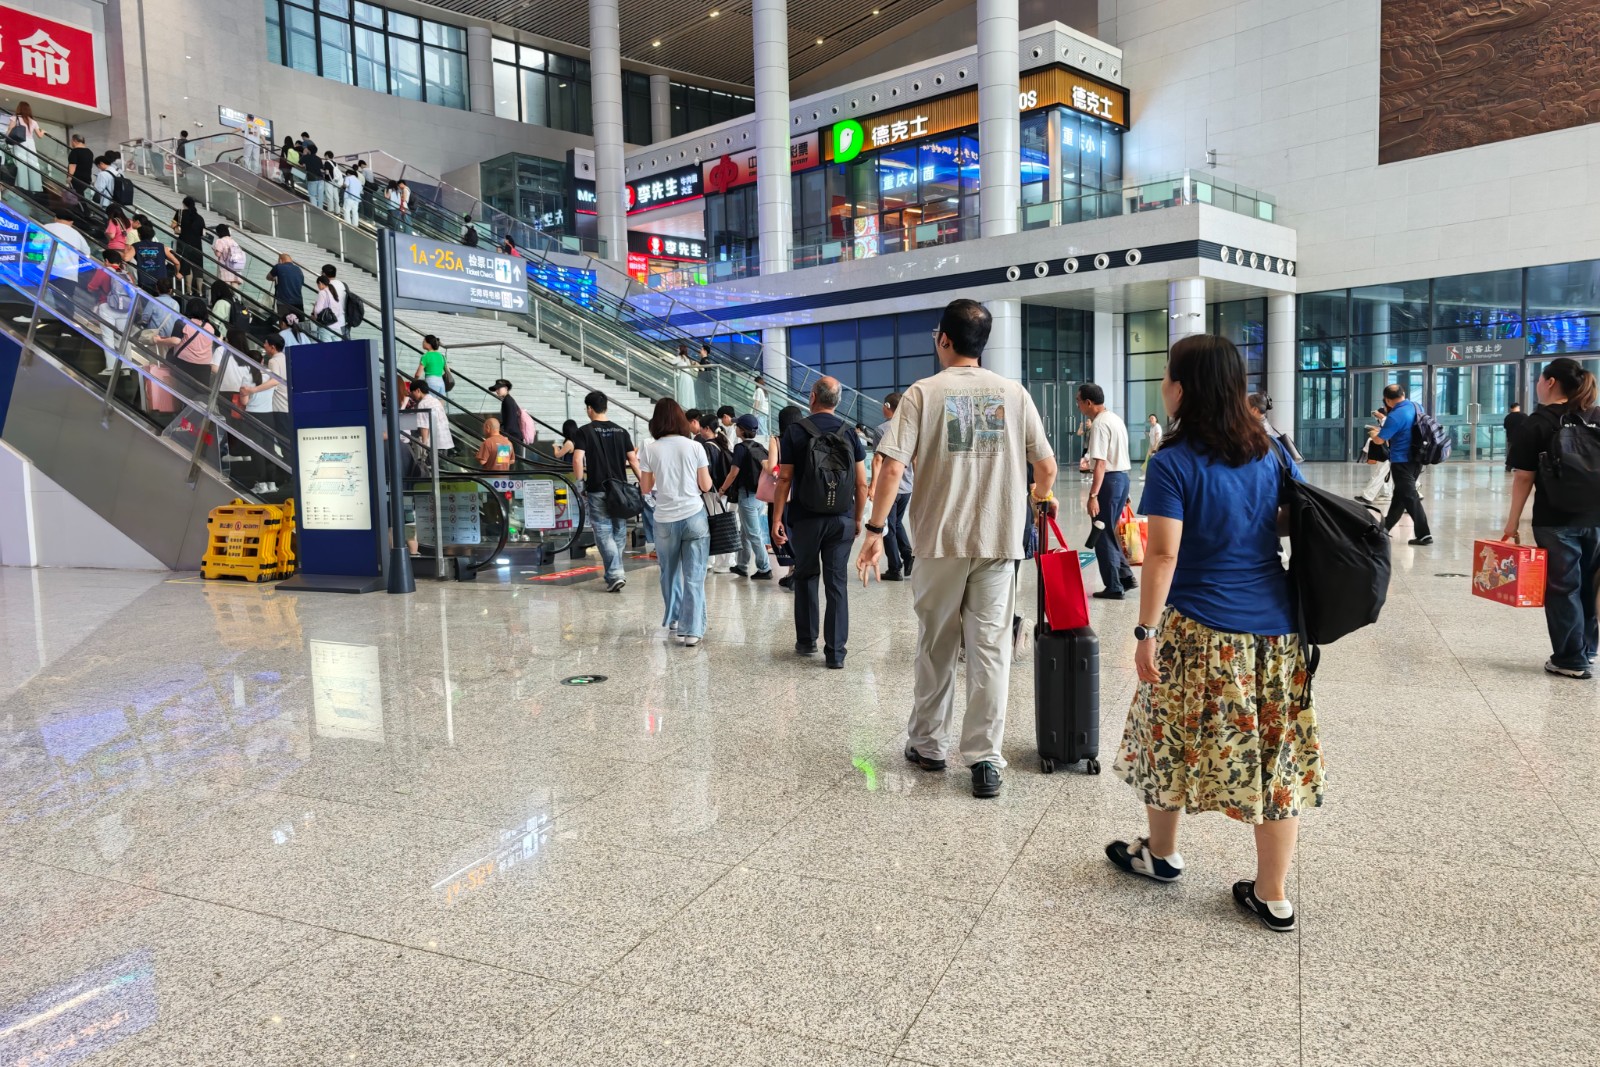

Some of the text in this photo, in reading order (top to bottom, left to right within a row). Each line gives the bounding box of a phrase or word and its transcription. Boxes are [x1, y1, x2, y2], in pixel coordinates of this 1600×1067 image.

[0, 25, 70, 86] 命
[1072, 85, 1113, 119] 德克士
[871, 115, 929, 147] 德克士
[637, 177, 678, 204] 李先生
[883, 165, 935, 190] 重庆小面
[409, 243, 465, 272] 1A-25A
[468, 253, 494, 270] 检票口
[665, 240, 702, 258] 李先生
[465, 267, 495, 279] Ticket Check
[1465, 343, 1503, 354] 旅客止步
